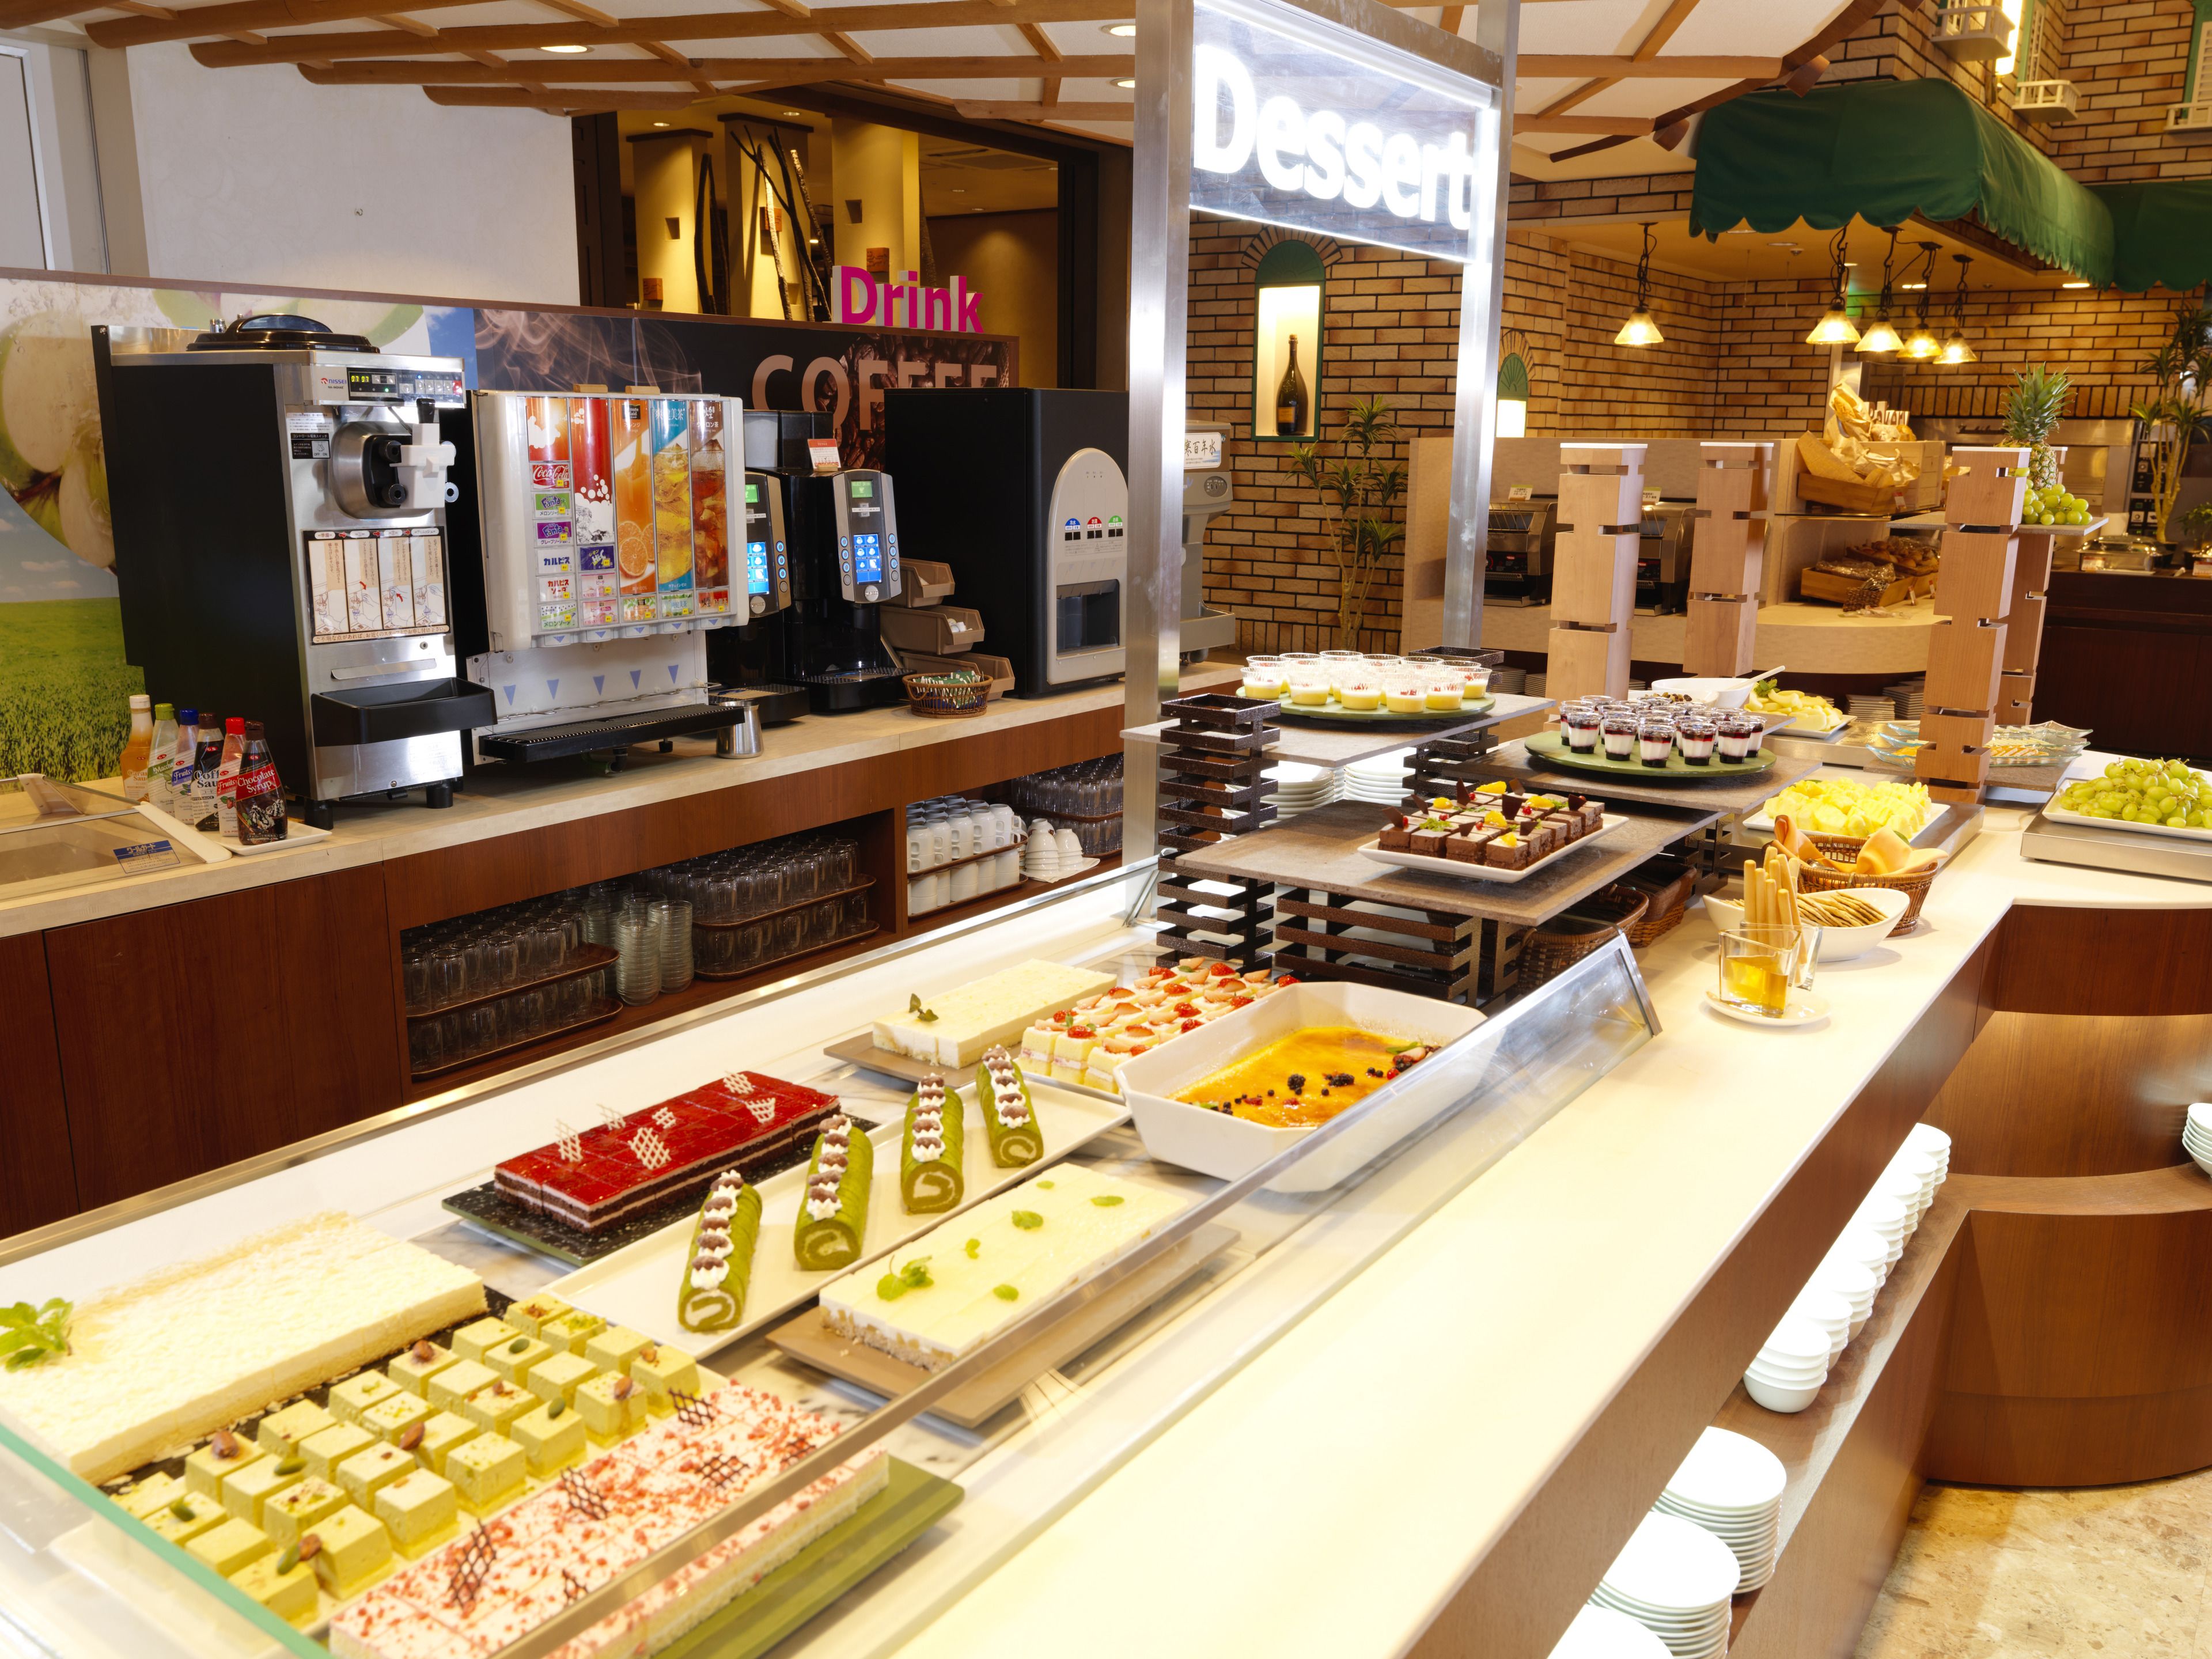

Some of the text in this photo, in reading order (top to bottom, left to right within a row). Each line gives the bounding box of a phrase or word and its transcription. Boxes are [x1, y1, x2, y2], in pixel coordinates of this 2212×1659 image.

[1193, 44, 1475, 230] Dessert
[838, 266, 984, 333] Drink
[533, 465, 570, 482] Coca-Cola
[541, 496, 561, 509] Fanta
[542, 525, 562, 537] Fanta
[544, 556, 570, 566] カルピス
[548, 579, 569, 587] カルピス
[237, 769, 275, 787] Chocolate
[247, 780, 272, 794] Syrup
